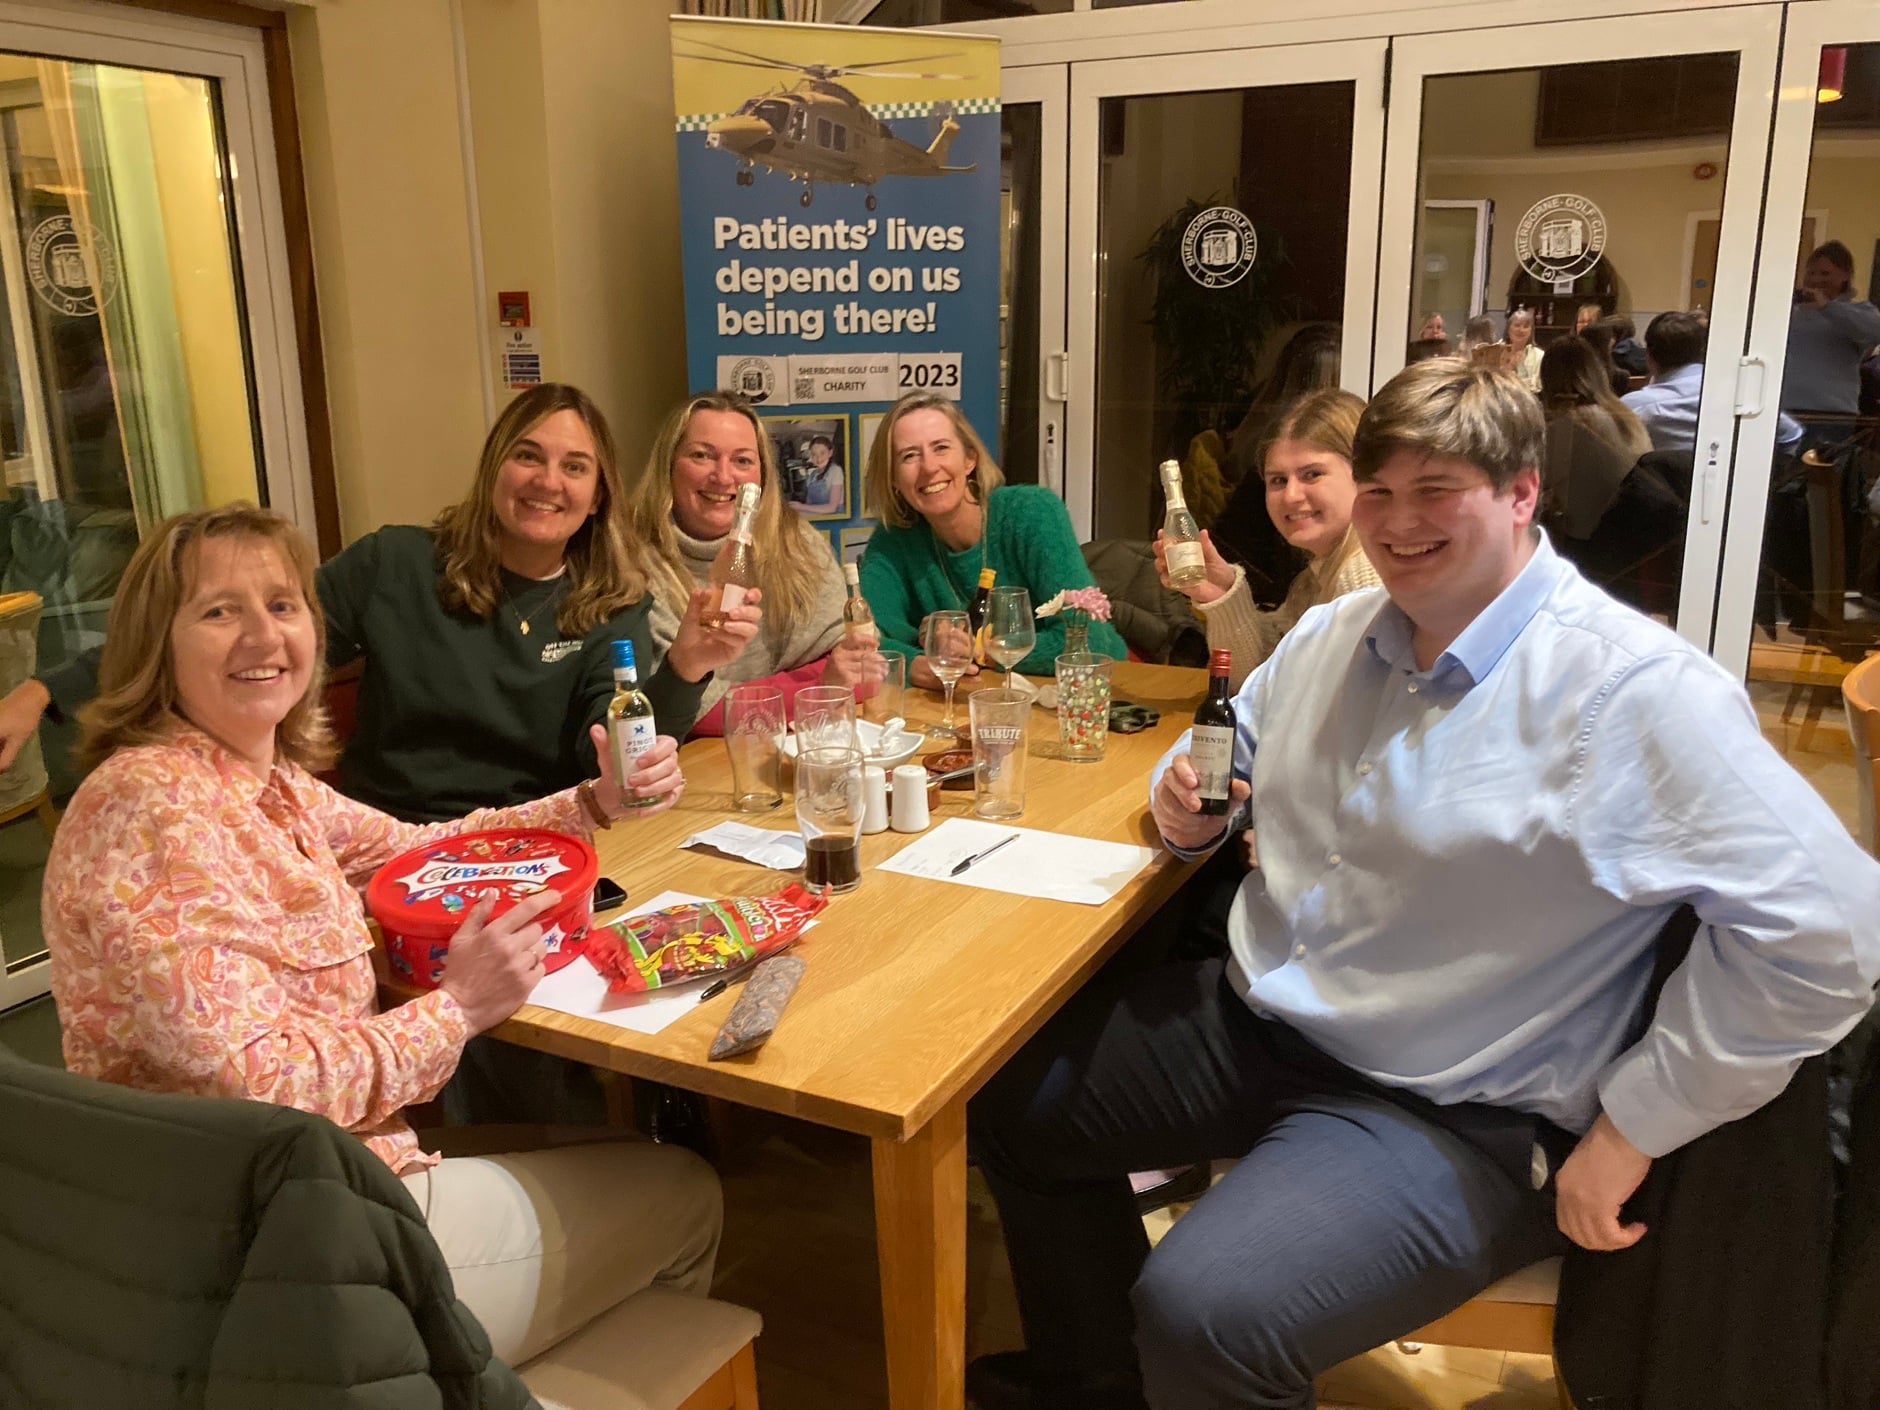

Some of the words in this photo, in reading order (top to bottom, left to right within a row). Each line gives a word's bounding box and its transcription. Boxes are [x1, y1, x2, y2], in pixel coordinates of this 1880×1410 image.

[714, 216, 877, 250] Patients’
[887, 218, 965, 251] lives
[1184, 210, 1218, 267] SHERBORNE
[1222, 210, 1247, 228] GOLF
[1244, 232, 1254, 261] CLUB
[1519, 198, 1560, 261] SHERBORNE
[1565, 198, 1596, 217] GOLF
[1591, 219, 1603, 252] CLUB
[30, 219, 67, 289] SHERBORNE
[715, 259, 859, 299] depend
[868, 266, 913, 292] on
[922, 266, 961, 292] us
[717, 302, 824, 340] being
[833, 302, 937, 334] there!
[798, 366, 846, 376] SHERBORNE
[848, 366, 868, 375] GOLF
[870, 365, 889, 375] CLUB
[823, 381, 866, 392] CHARITY
[900, 364, 959, 388] 2023
[978, 728, 1021, 740] TRIBUTE
